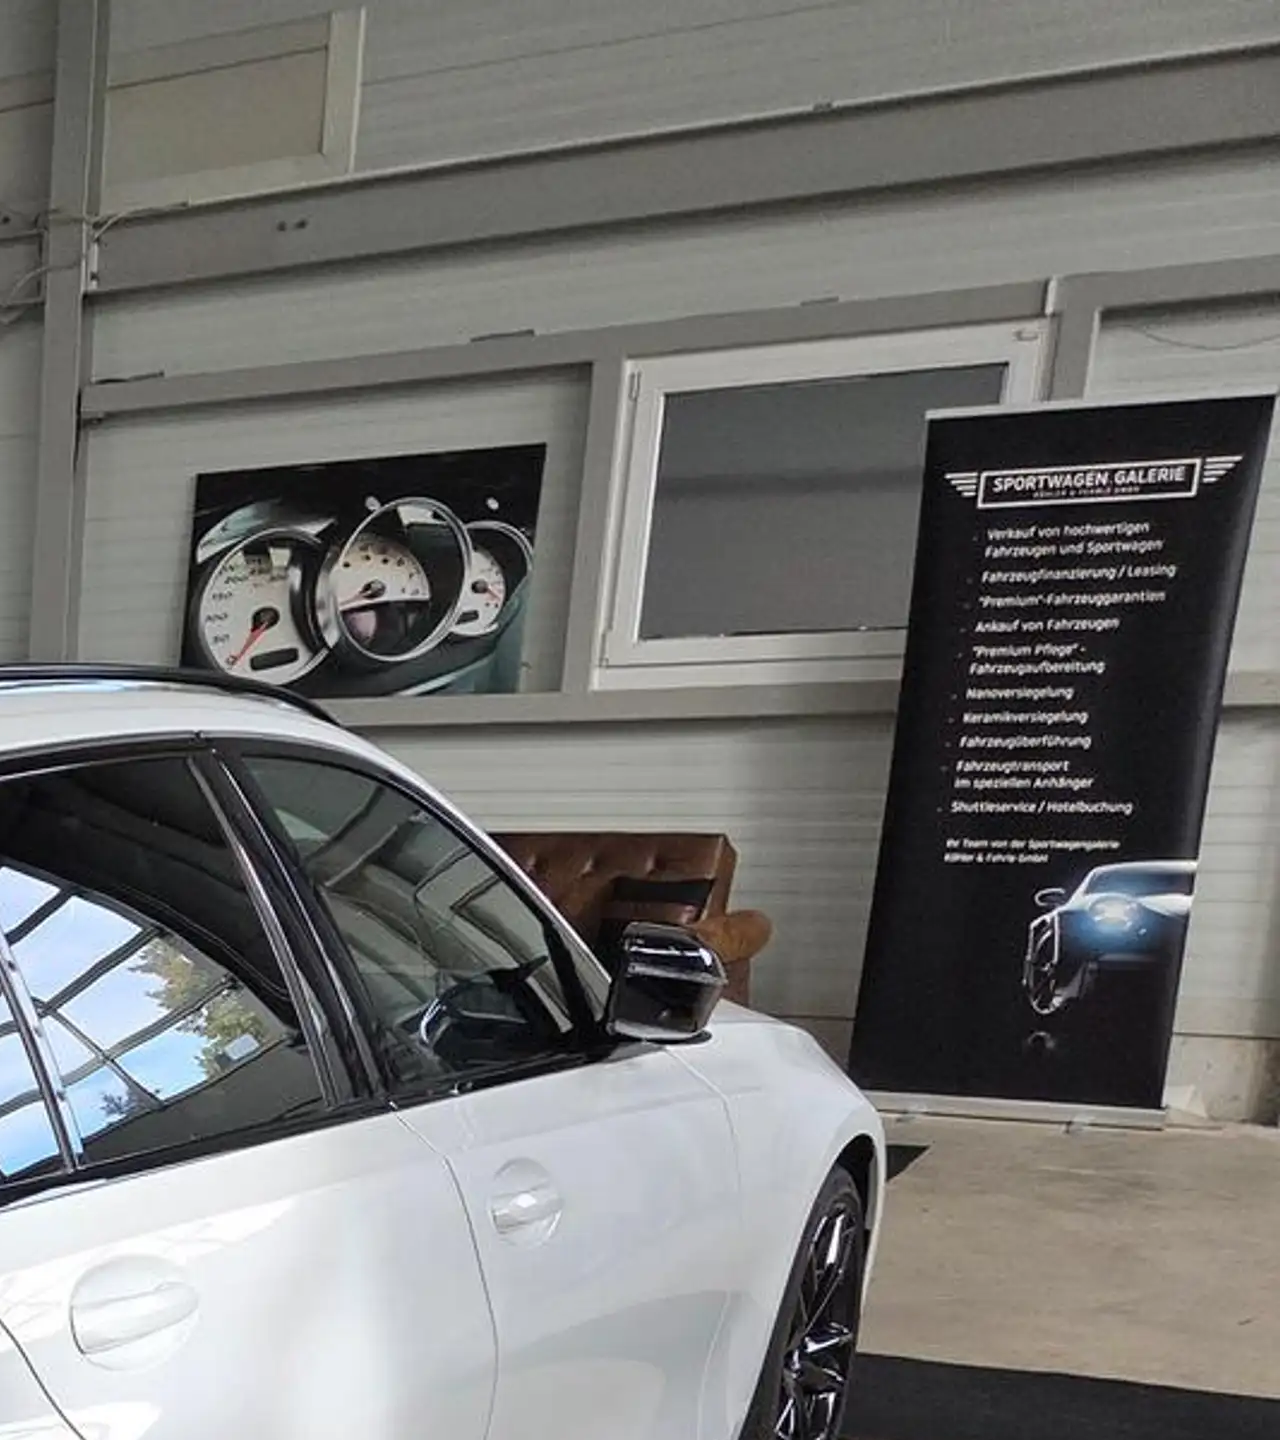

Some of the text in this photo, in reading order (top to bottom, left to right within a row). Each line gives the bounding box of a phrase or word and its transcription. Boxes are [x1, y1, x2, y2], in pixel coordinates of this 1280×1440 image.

[992, 473, 1109, 493] SPORTWAGEN
[1114, 465, 1186, 485] GALERIE
[988, 521, 1150, 541] Verkauf von hochwertigen
[985, 540, 1164, 559] Fahrzeugen und Sportwagen
[982, 566, 1117, 584] Fahrzeugfinanzierung
[1127, 564, 1177, 579] Leasing
[975, 617, 1120, 633] Ankauf von Fahrzeugen
[969, 659, 1106, 676] Fahrzeugaufbereitung
[966, 685, 1075, 701] Nanoversiegelung
[963, 710, 1089, 725] Keramikversiegelung
[959, 734, 1092, 750] Fahrzeugüberführung
[956, 760, 1070, 774] Fahrzeugtransport
[1033, 776, 1095, 792] Anhänger
[951, 801, 1037, 814] Shuttleservice
[1047, 801, 1134, 817] Hotelbuchung
